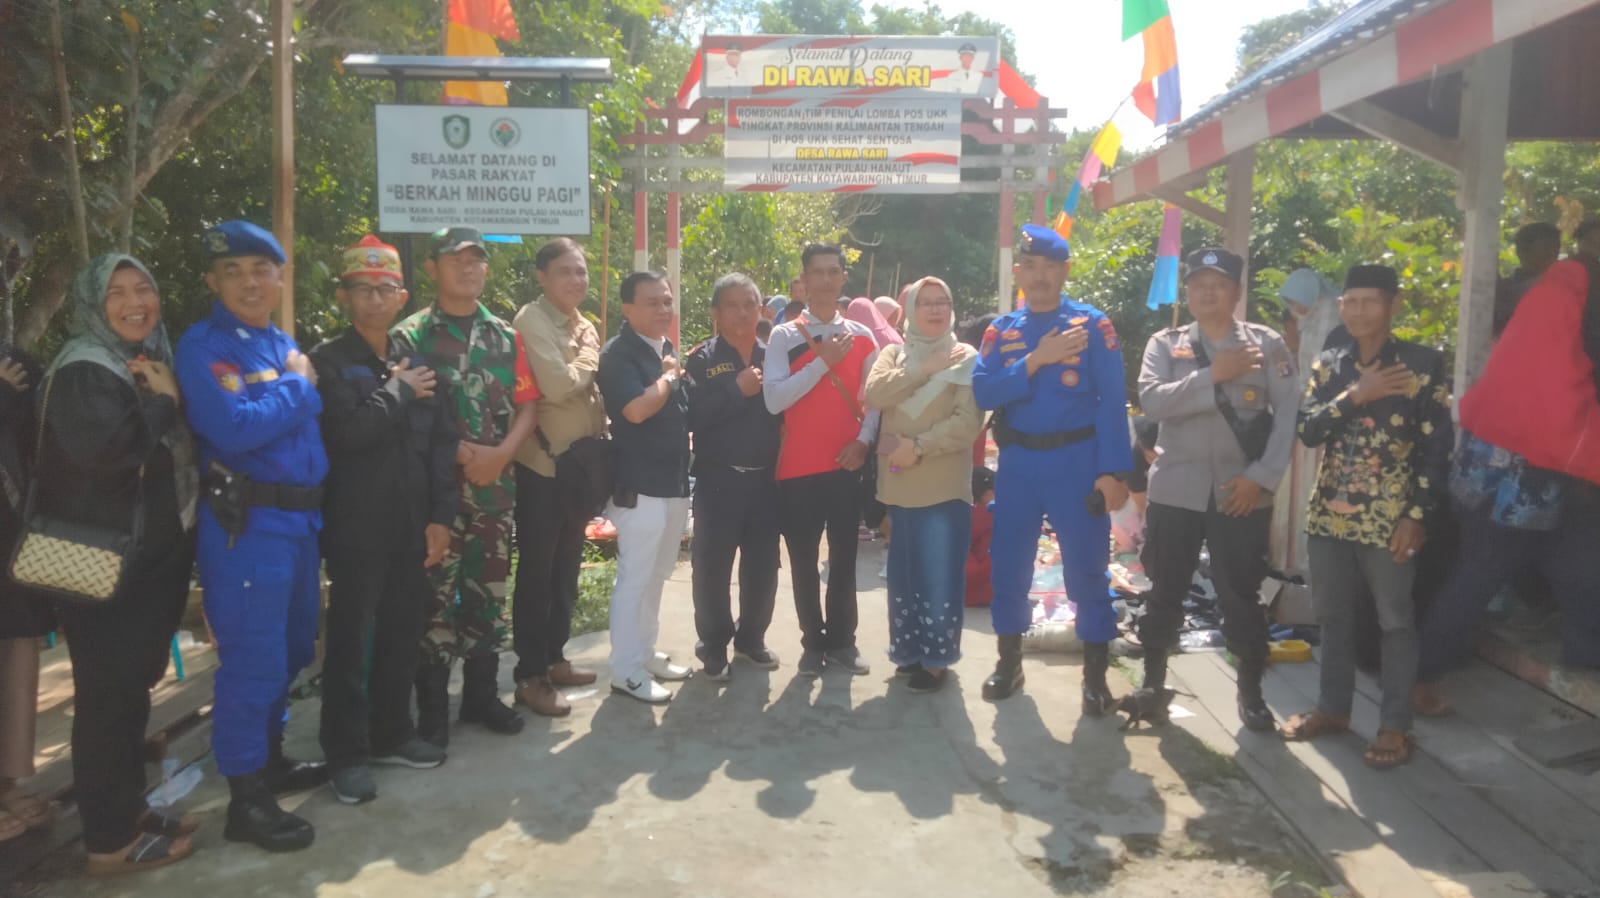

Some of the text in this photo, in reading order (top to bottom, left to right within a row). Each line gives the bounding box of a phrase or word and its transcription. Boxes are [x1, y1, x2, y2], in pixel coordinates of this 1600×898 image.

[781, 46, 913, 67] Selamat Datang
[763, 65, 932, 88] DI RAWA SARI
[738, 108, 948, 119] ROMBONGAN TIM PENILAI LOMBA POS UKK
[742, 122, 944, 132] TINGKAT PROVINSI KALIMANTAN TENGAH
[772, 135, 912, 145] DI POS UKK SEHAT SENTOSA
[411, 153, 556, 167] SELAMAT DATANG DI
[796, 147, 888, 160] DESA RAWA SARI
[431, 168, 536, 181] PASAR RAKYAT
[772, 163, 912, 173] KECAMATAN PULAU HANAUT
[756, 174, 928, 184] KABUPATEN KOTAWARINGIN TIMUR
[466, 186, 532, 202] MINGGU
